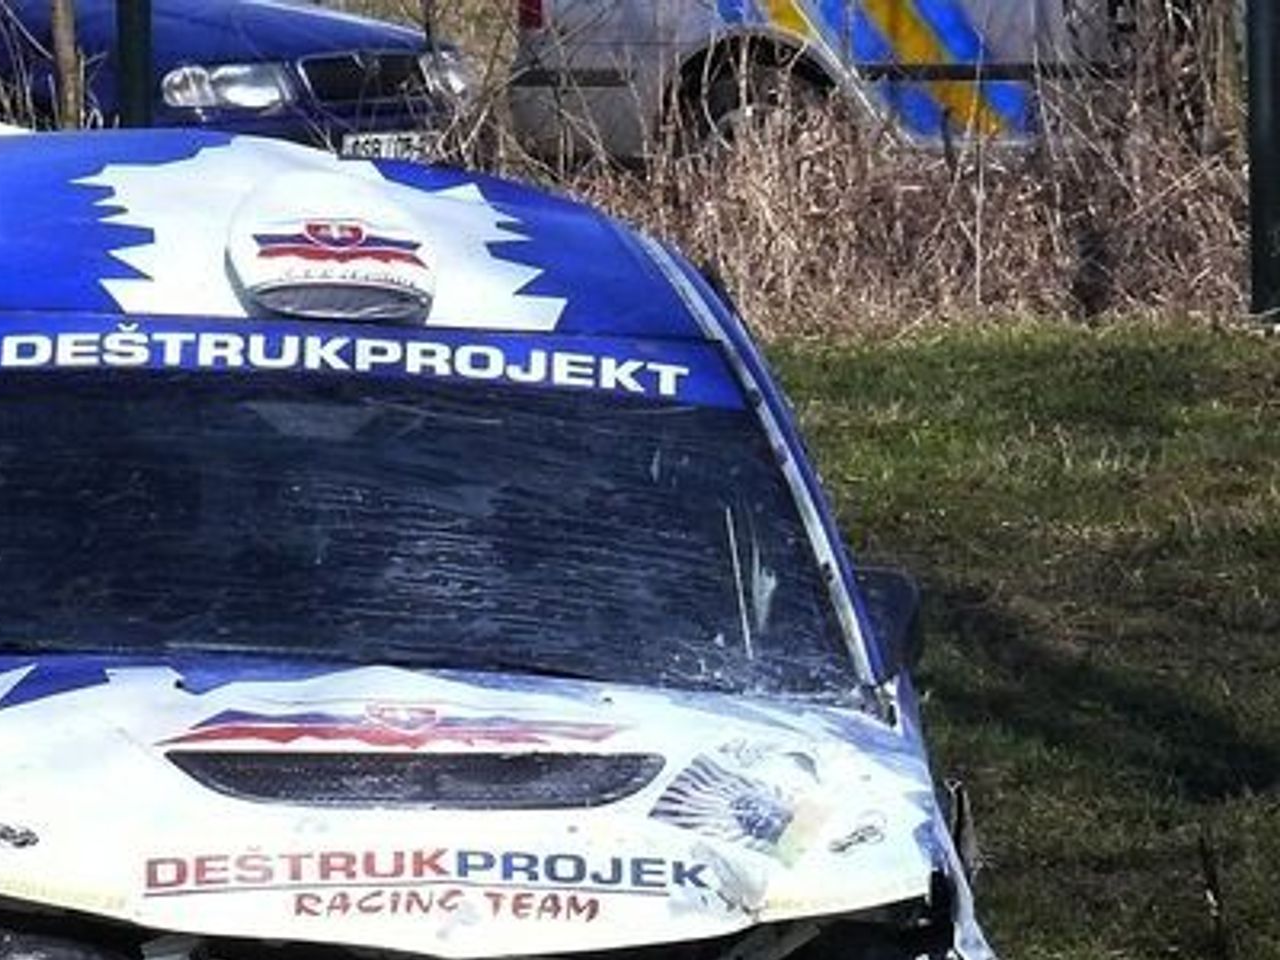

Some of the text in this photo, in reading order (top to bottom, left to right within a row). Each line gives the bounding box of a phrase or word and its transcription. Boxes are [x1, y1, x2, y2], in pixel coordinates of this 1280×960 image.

[0, 323, 690, 396] DEŠTRUKPROJEKT
[294, 890, 600, 922] RACING TEAM
